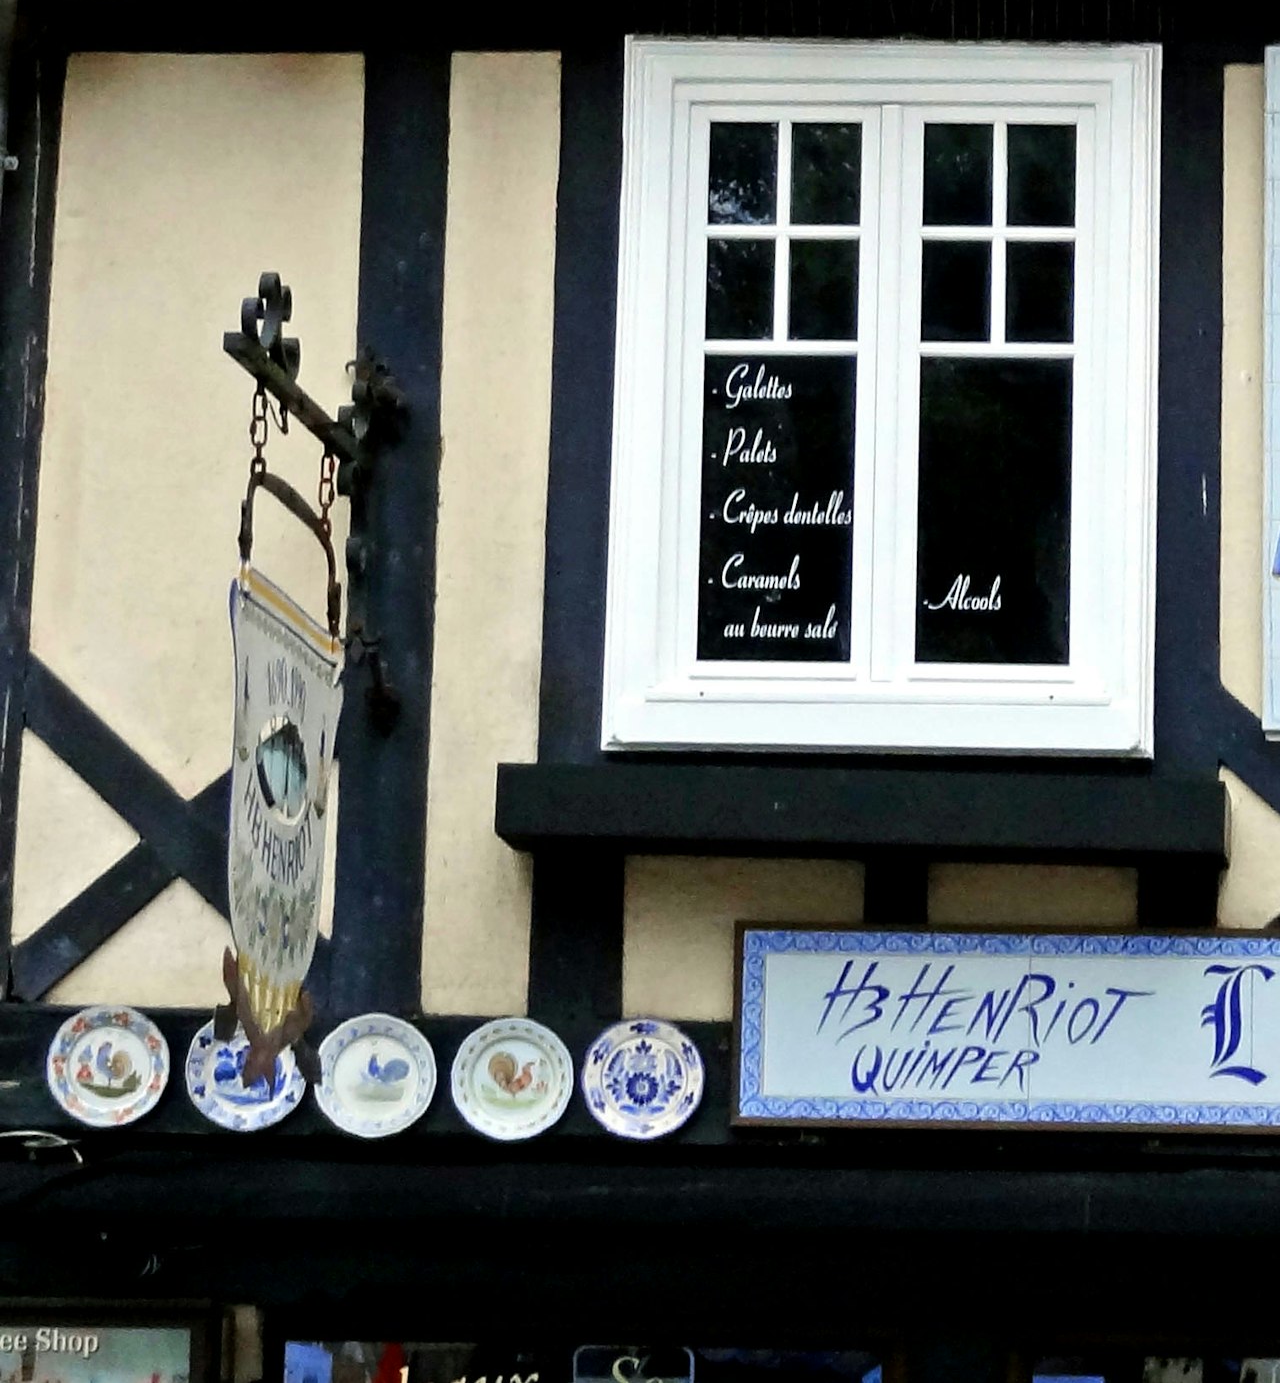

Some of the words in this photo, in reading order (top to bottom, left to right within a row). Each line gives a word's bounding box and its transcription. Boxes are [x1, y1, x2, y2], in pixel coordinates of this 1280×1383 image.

[725, 364, 792, 408] Galettes
[723, 427, 777, 466] Palets
[722, 489, 778, 534] Crêpes
[783, 489, 852, 525] dentelles
[721, 553, 801, 590] Caramels
[928, 573, 1002, 611] Alcools
[723, 622, 745, 638] au
[750, 605, 800, 638] beurre
[804, 602, 838, 639] salé
[35, 1327, 99, 1359] Shop
